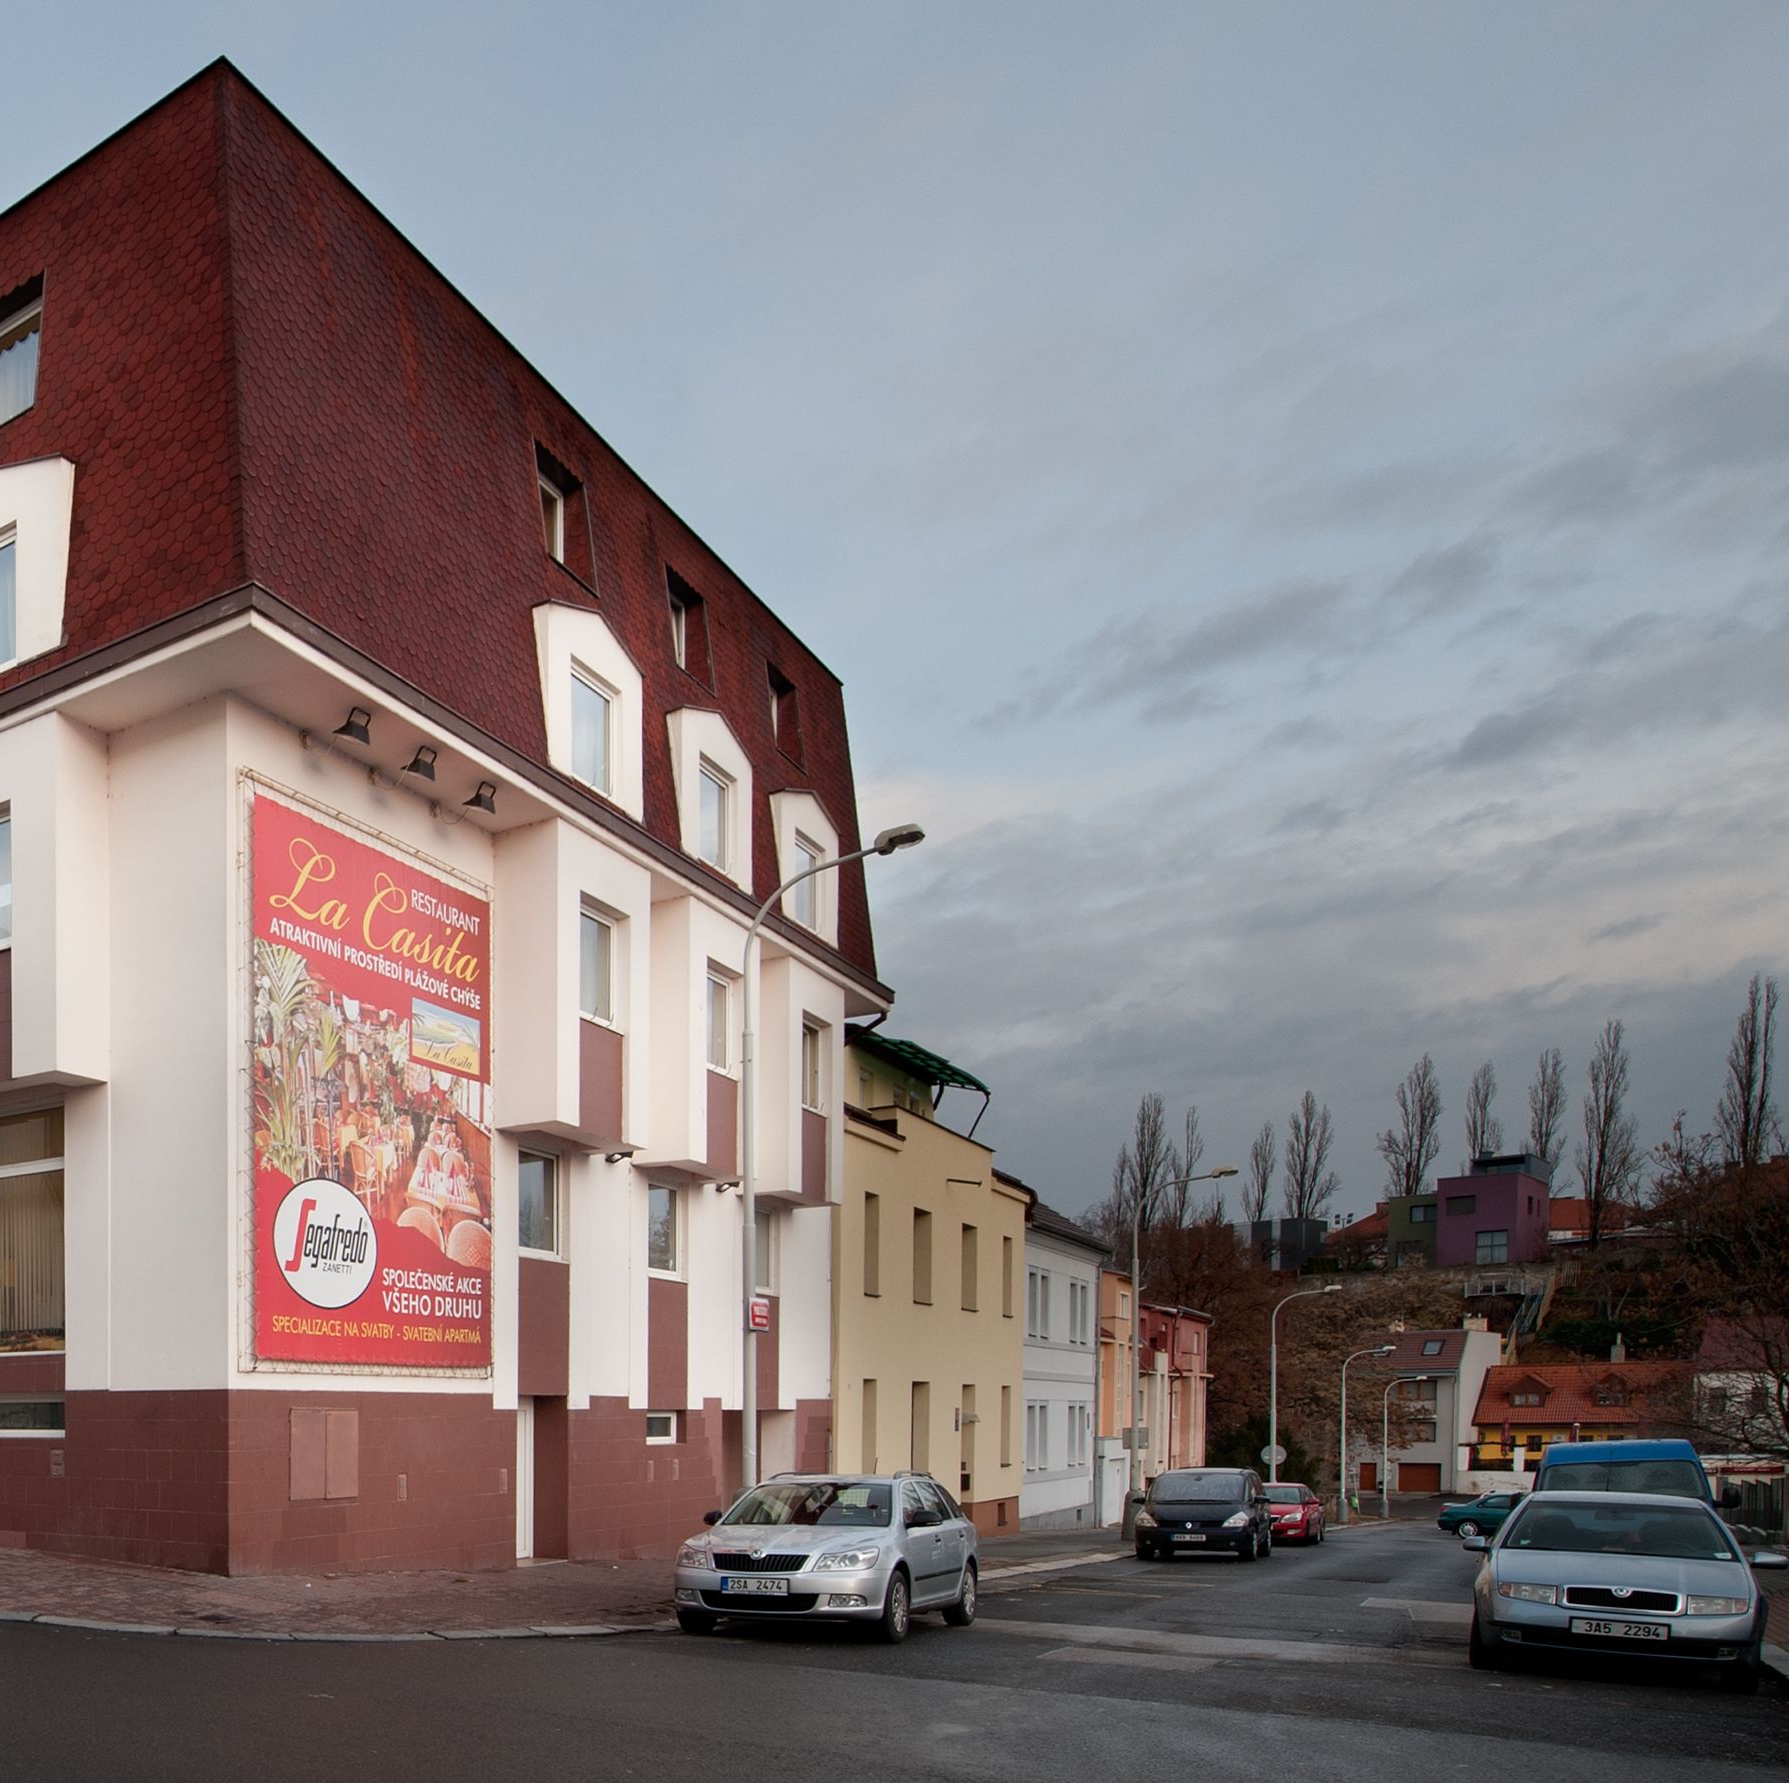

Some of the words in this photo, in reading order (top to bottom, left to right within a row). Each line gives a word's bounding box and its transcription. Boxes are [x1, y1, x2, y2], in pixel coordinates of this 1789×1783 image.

[269, 837, 350, 930] La
[363, 872, 480, 982] Casita
[411, 889, 480, 935] RESTAURANT
[270, 917, 341, 957] ATRAKTIVNÍ
[344, 945, 403, 982] PROSTŘEDÍ
[404, 967, 449, 998] PLÁŽOVÉ
[450, 987, 481, 1010] CHÝŠE
[284, 1198, 368, 1272] Segafredo
[322, 1262, 352, 1275] ZANETTI
[382, 1267, 454, 1293] SPOLEČENSKÉ
[456, 1276, 482, 1295] AKCE
[382, 1288, 432, 1316] VŠEHO
[435, 1298, 482, 1319] DRUHU
[272, 1315, 342, 1338] SPECIALIZACE
[344, 1324, 359, 1337] NA
[361, 1324, 394, 1339] SVATBY
[402, 1325, 443, 1342] SVATEBNÍ
[444, 1328, 481, 1344] APARTMÁ
[730, 1579, 748, 1590] 2SA
[756, 1580, 782, 1591] 2474
[1584, 1621, 1612, 1634] 3A5
[1623, 1625, 1660, 1638] 2294
